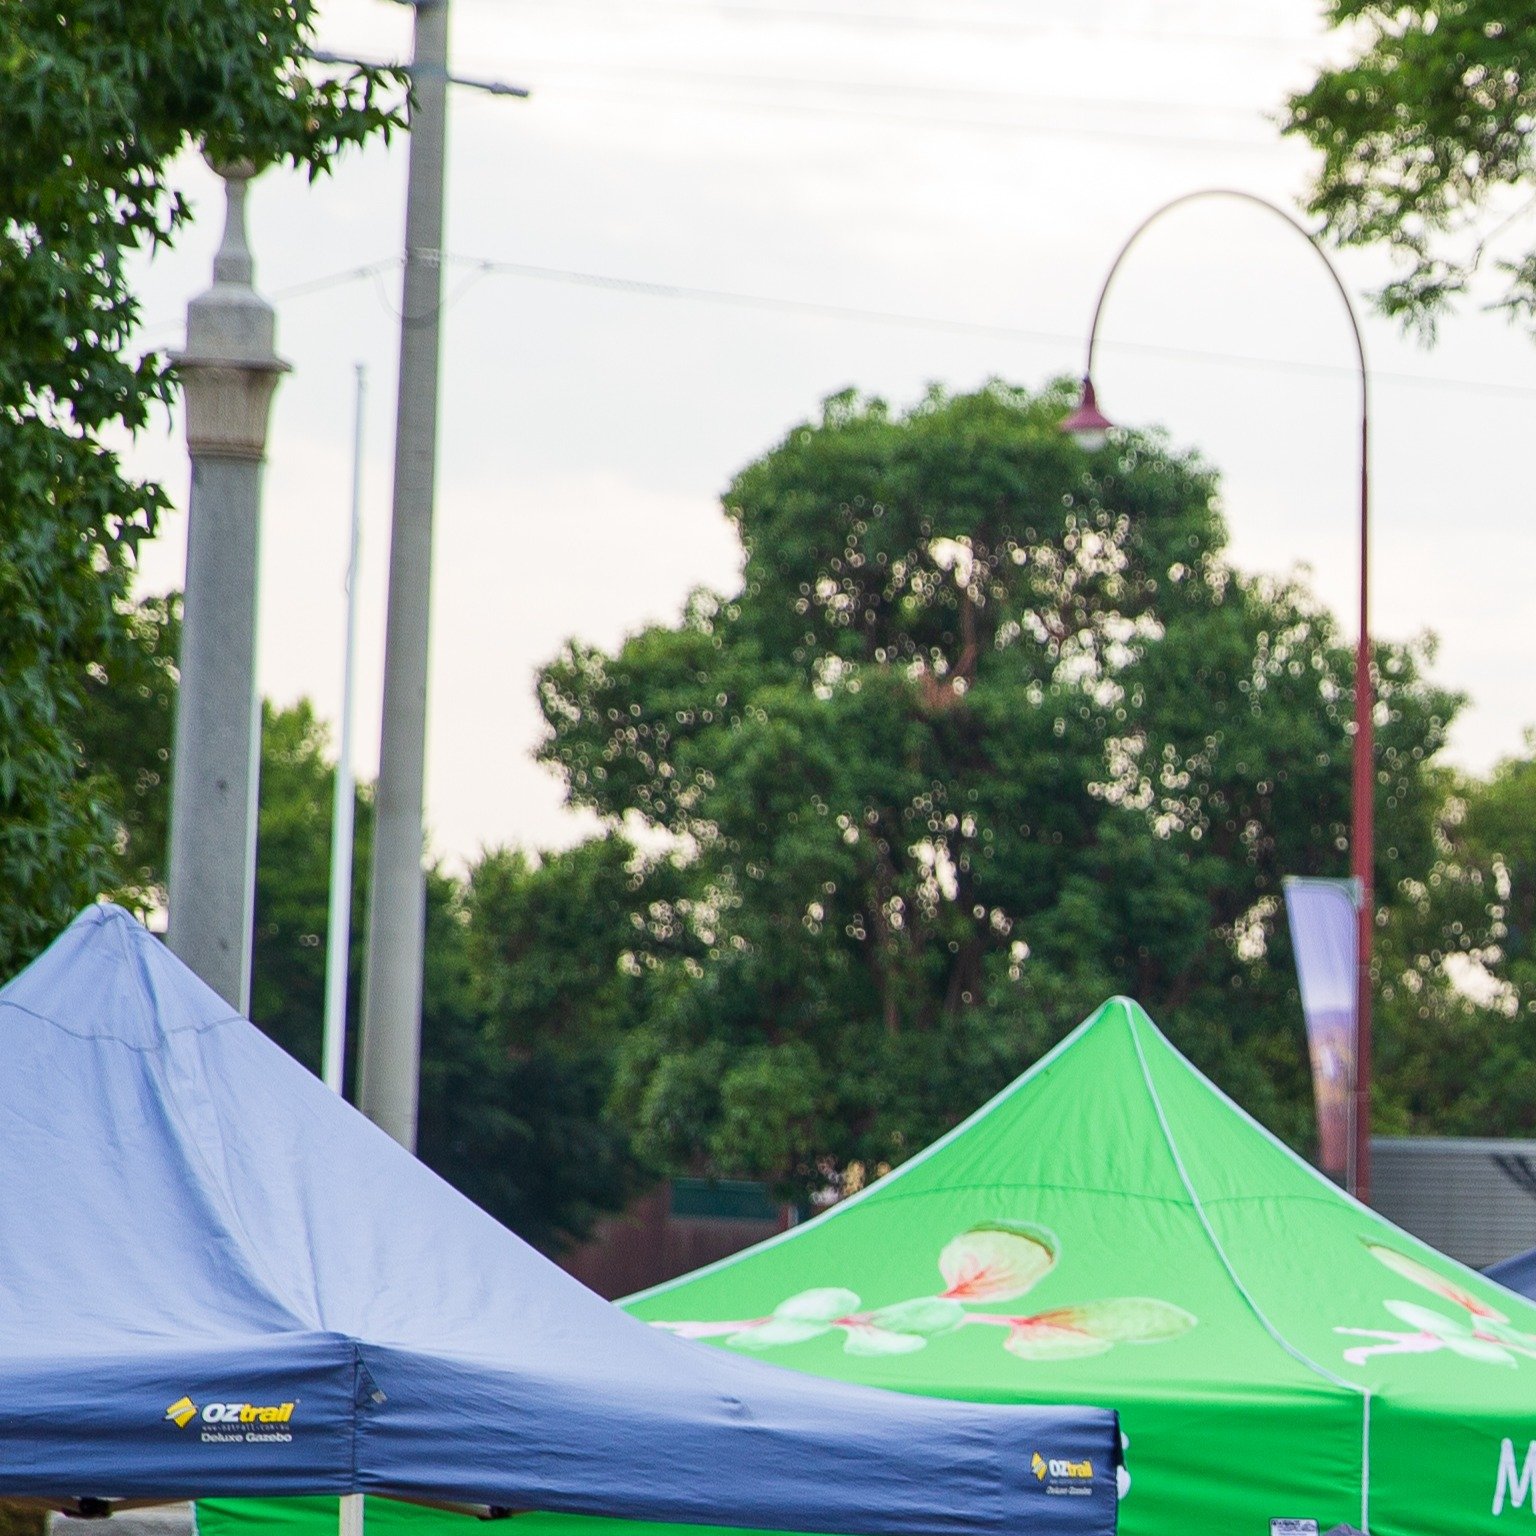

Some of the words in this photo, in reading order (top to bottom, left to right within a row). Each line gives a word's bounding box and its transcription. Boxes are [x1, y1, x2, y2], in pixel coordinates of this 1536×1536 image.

[202, 1402, 295, 1423] OZtrail
[201, 1432, 243, 1442] Deluxe
[245, 1432, 292, 1443] Gazebo
